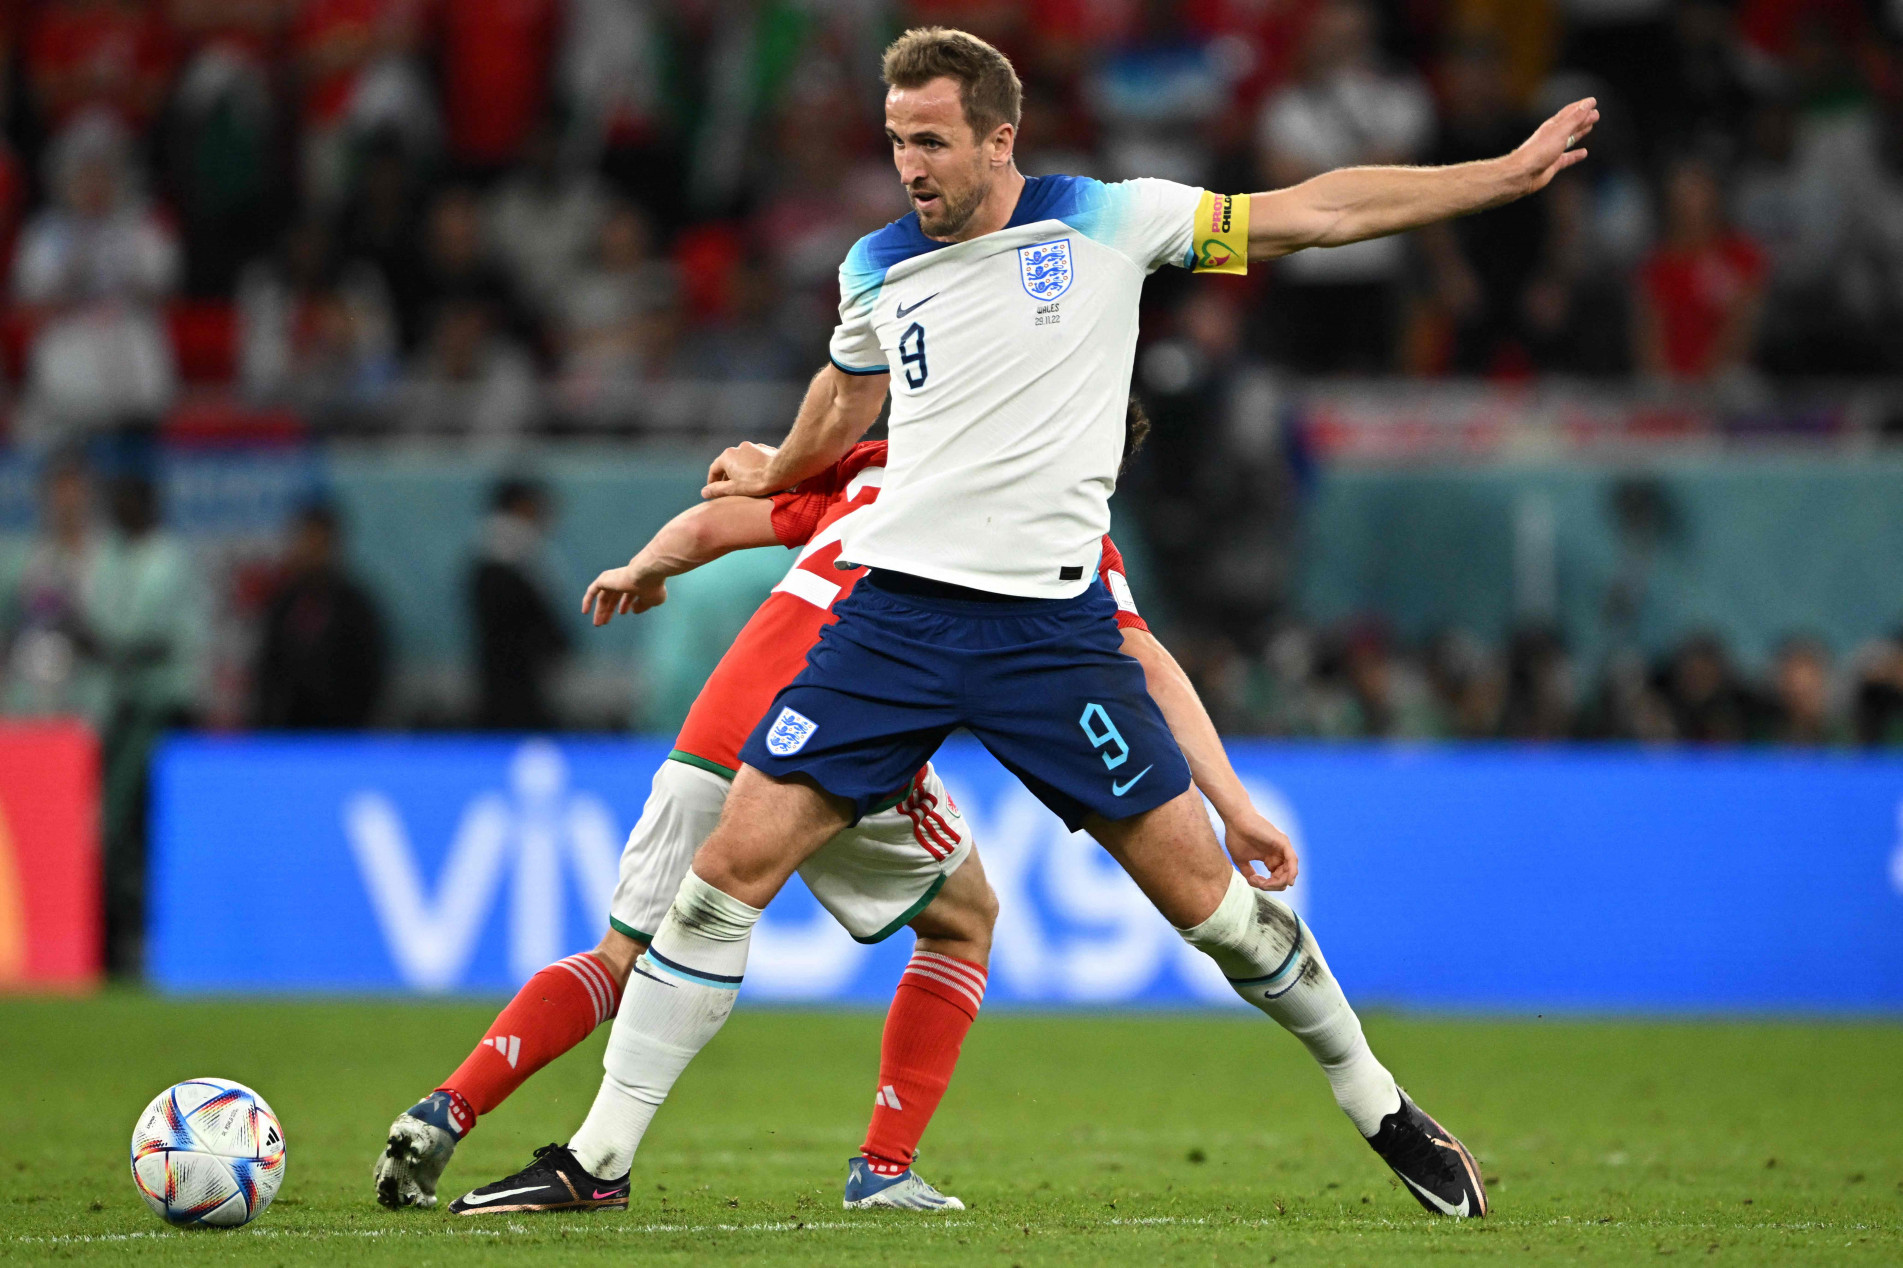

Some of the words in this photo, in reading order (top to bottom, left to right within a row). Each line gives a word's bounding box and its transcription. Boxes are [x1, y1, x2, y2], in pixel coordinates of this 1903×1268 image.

[1035, 315, 1060, 326] 29.11.22
[1037, 303, 1060, 314] WALES
[899, 321, 928, 390] 9
[1079, 702, 1129, 771] 9
